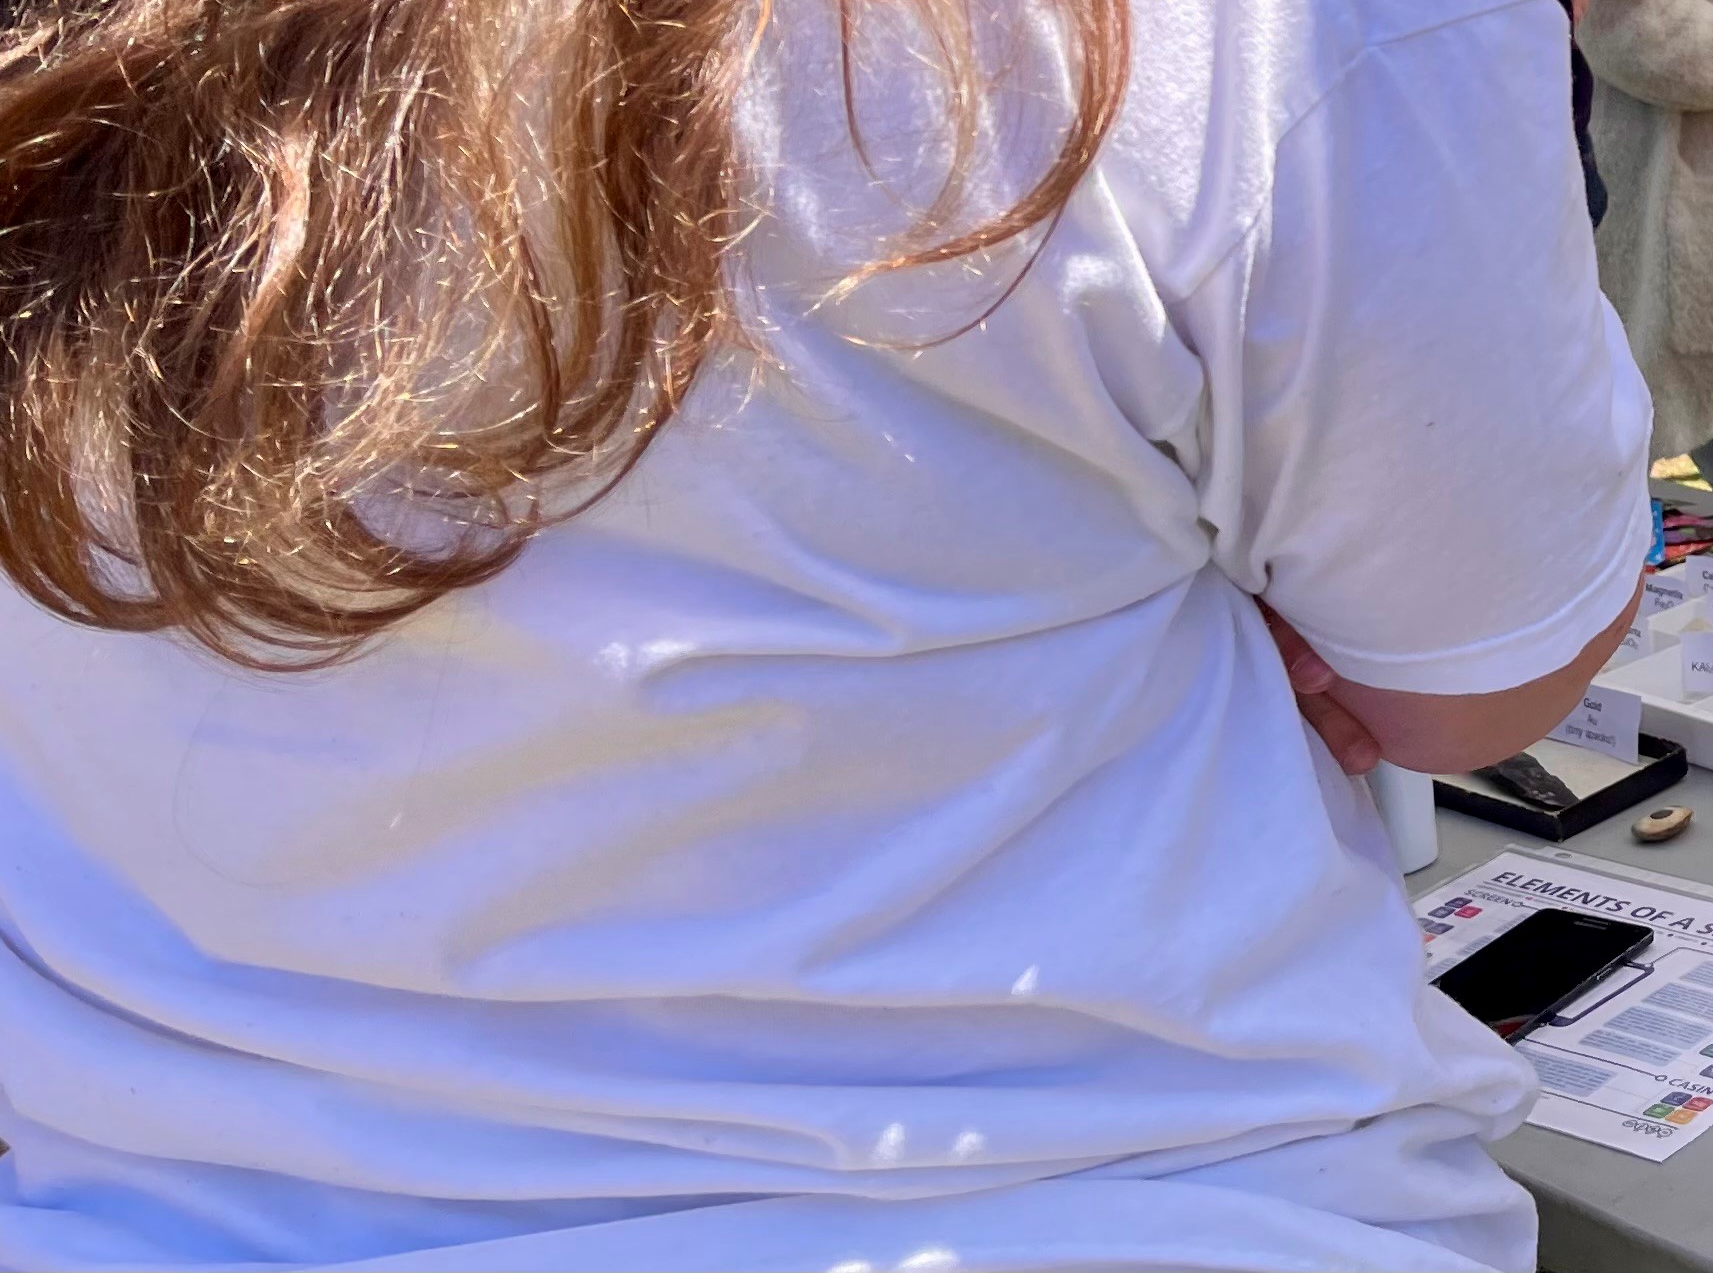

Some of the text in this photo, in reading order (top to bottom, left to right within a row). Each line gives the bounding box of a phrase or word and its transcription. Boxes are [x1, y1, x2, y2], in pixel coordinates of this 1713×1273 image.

[1584, 698, 1602, 712] Gold
[1464, 889, 1514, 906] SCREEN
[1491, 871, 1631, 914] ELEMENTS
[1631, 906, 1674, 922] OF
[1670, 917, 1695, 930] A
